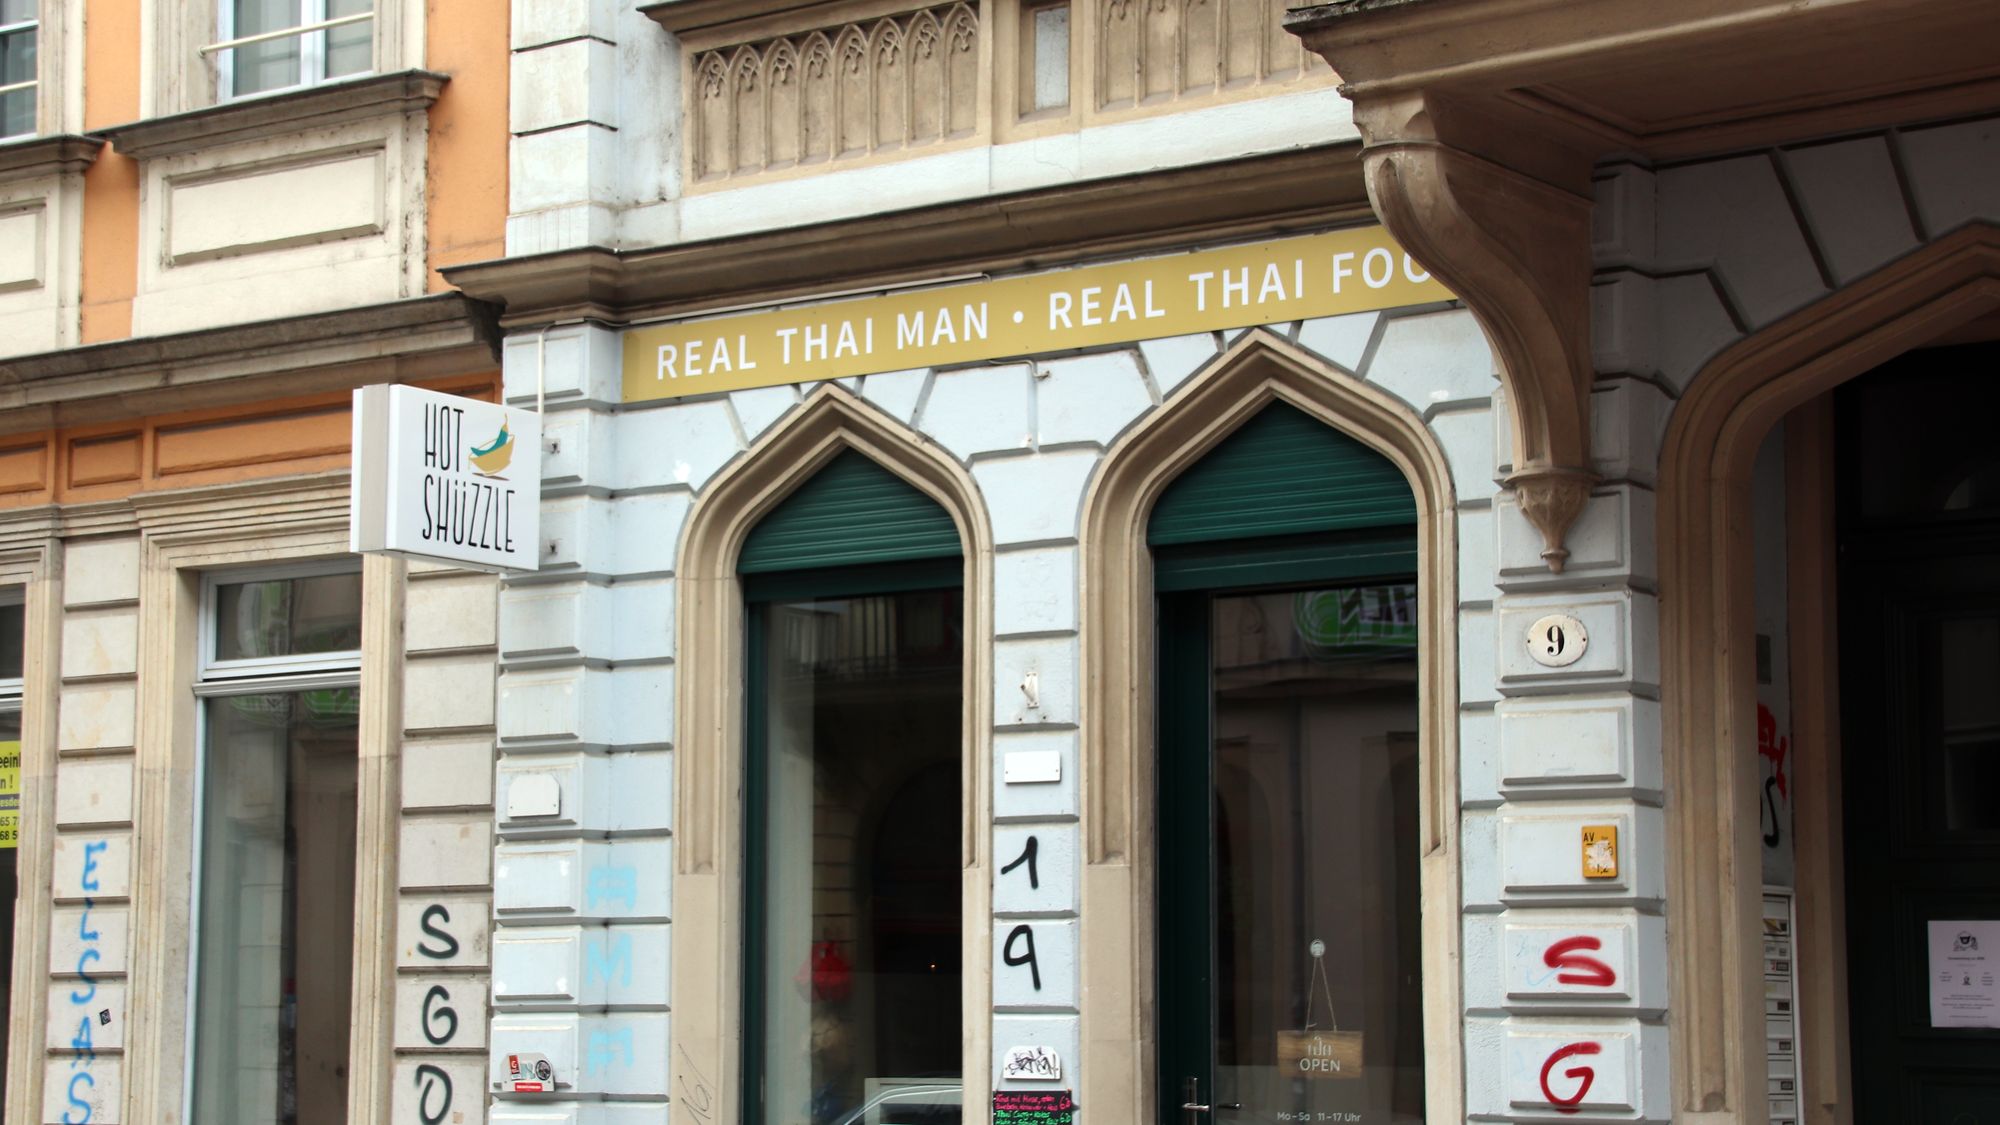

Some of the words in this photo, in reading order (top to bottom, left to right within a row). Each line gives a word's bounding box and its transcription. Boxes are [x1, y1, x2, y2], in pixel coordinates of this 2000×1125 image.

[657, 334, 757, 380] REAL
[776, 317, 873, 365] THAI
[897, 302, 988, 350] MAN
[1049, 279, 1166, 331] REAL
[1188, 258, 1304, 311] THAI
[425, 402, 464, 472] HOT
[1546, 624, 1565, 657] 9
[1583, 832, 1595, 842] AV
[1300, 1058, 1341, 1072] OPEN
[1344, 1112, 1361, 1122] Uhr
